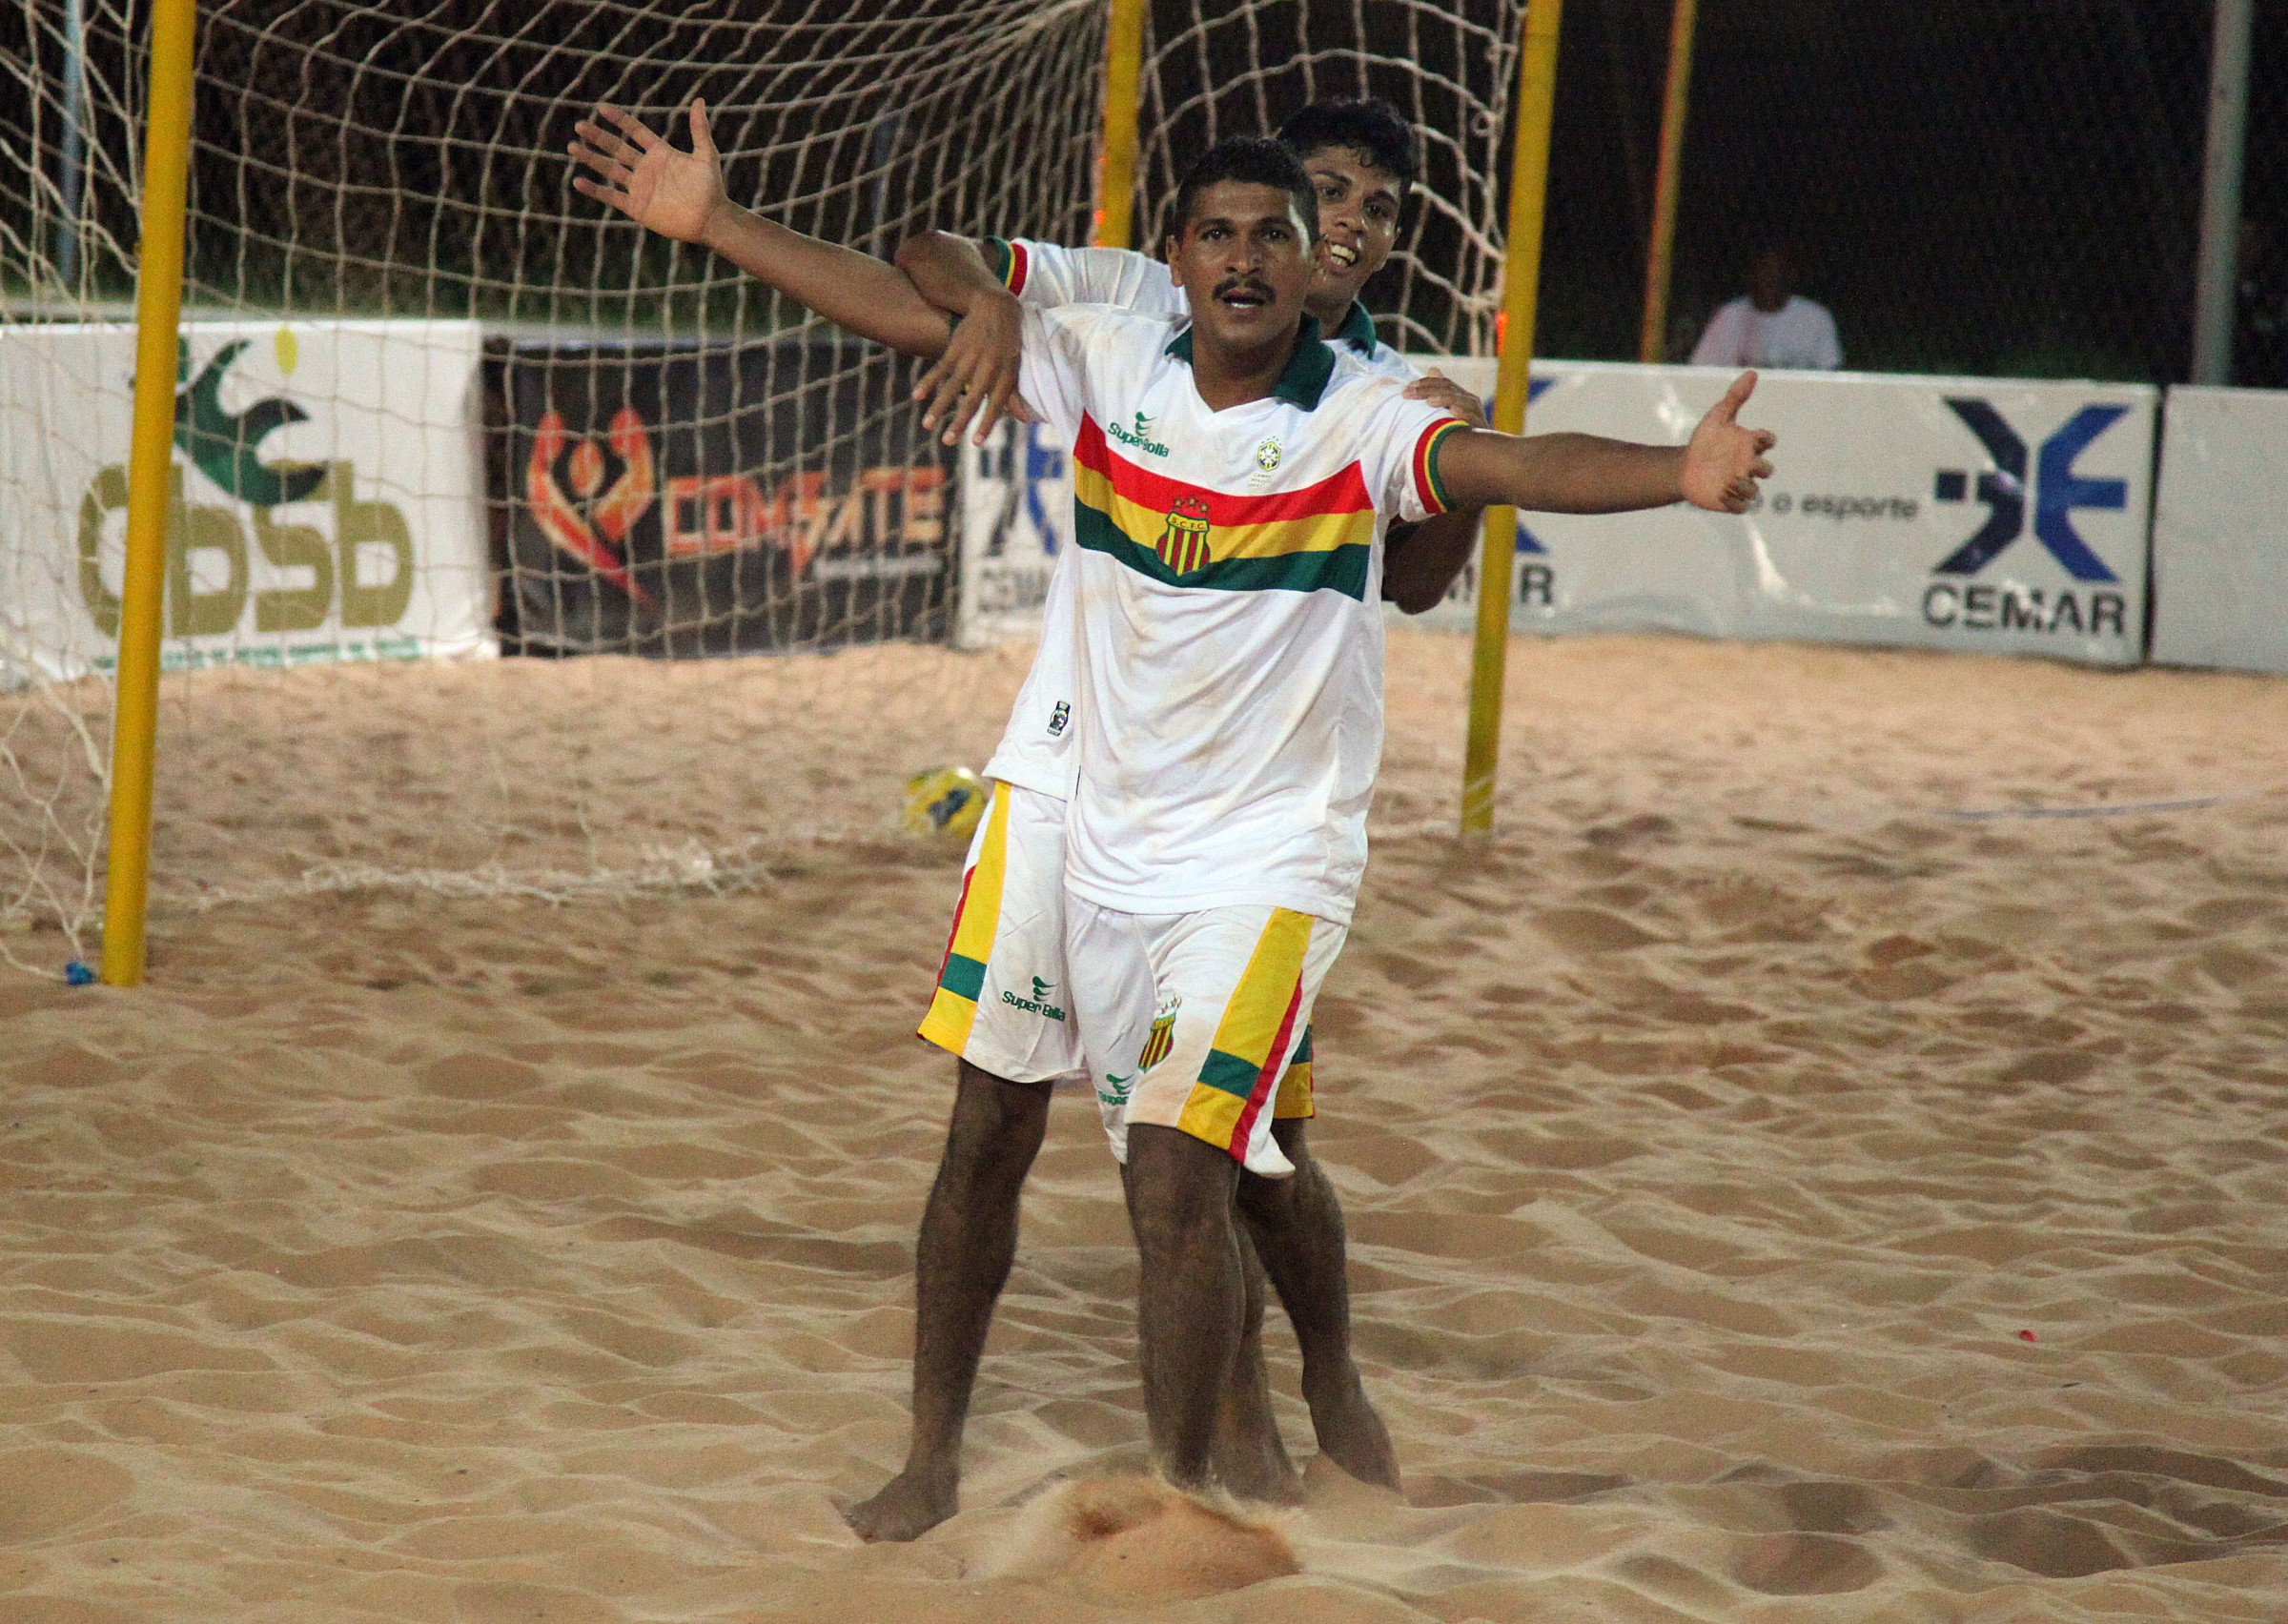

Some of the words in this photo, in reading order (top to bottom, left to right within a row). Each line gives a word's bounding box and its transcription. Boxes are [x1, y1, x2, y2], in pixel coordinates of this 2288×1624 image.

[1108, 422, 1144, 448] Super
[1802, 495, 1919, 522] esporte
[1923, 583, 2125, 637] CEMAR
[1002, 990, 1042, 1013] Super
